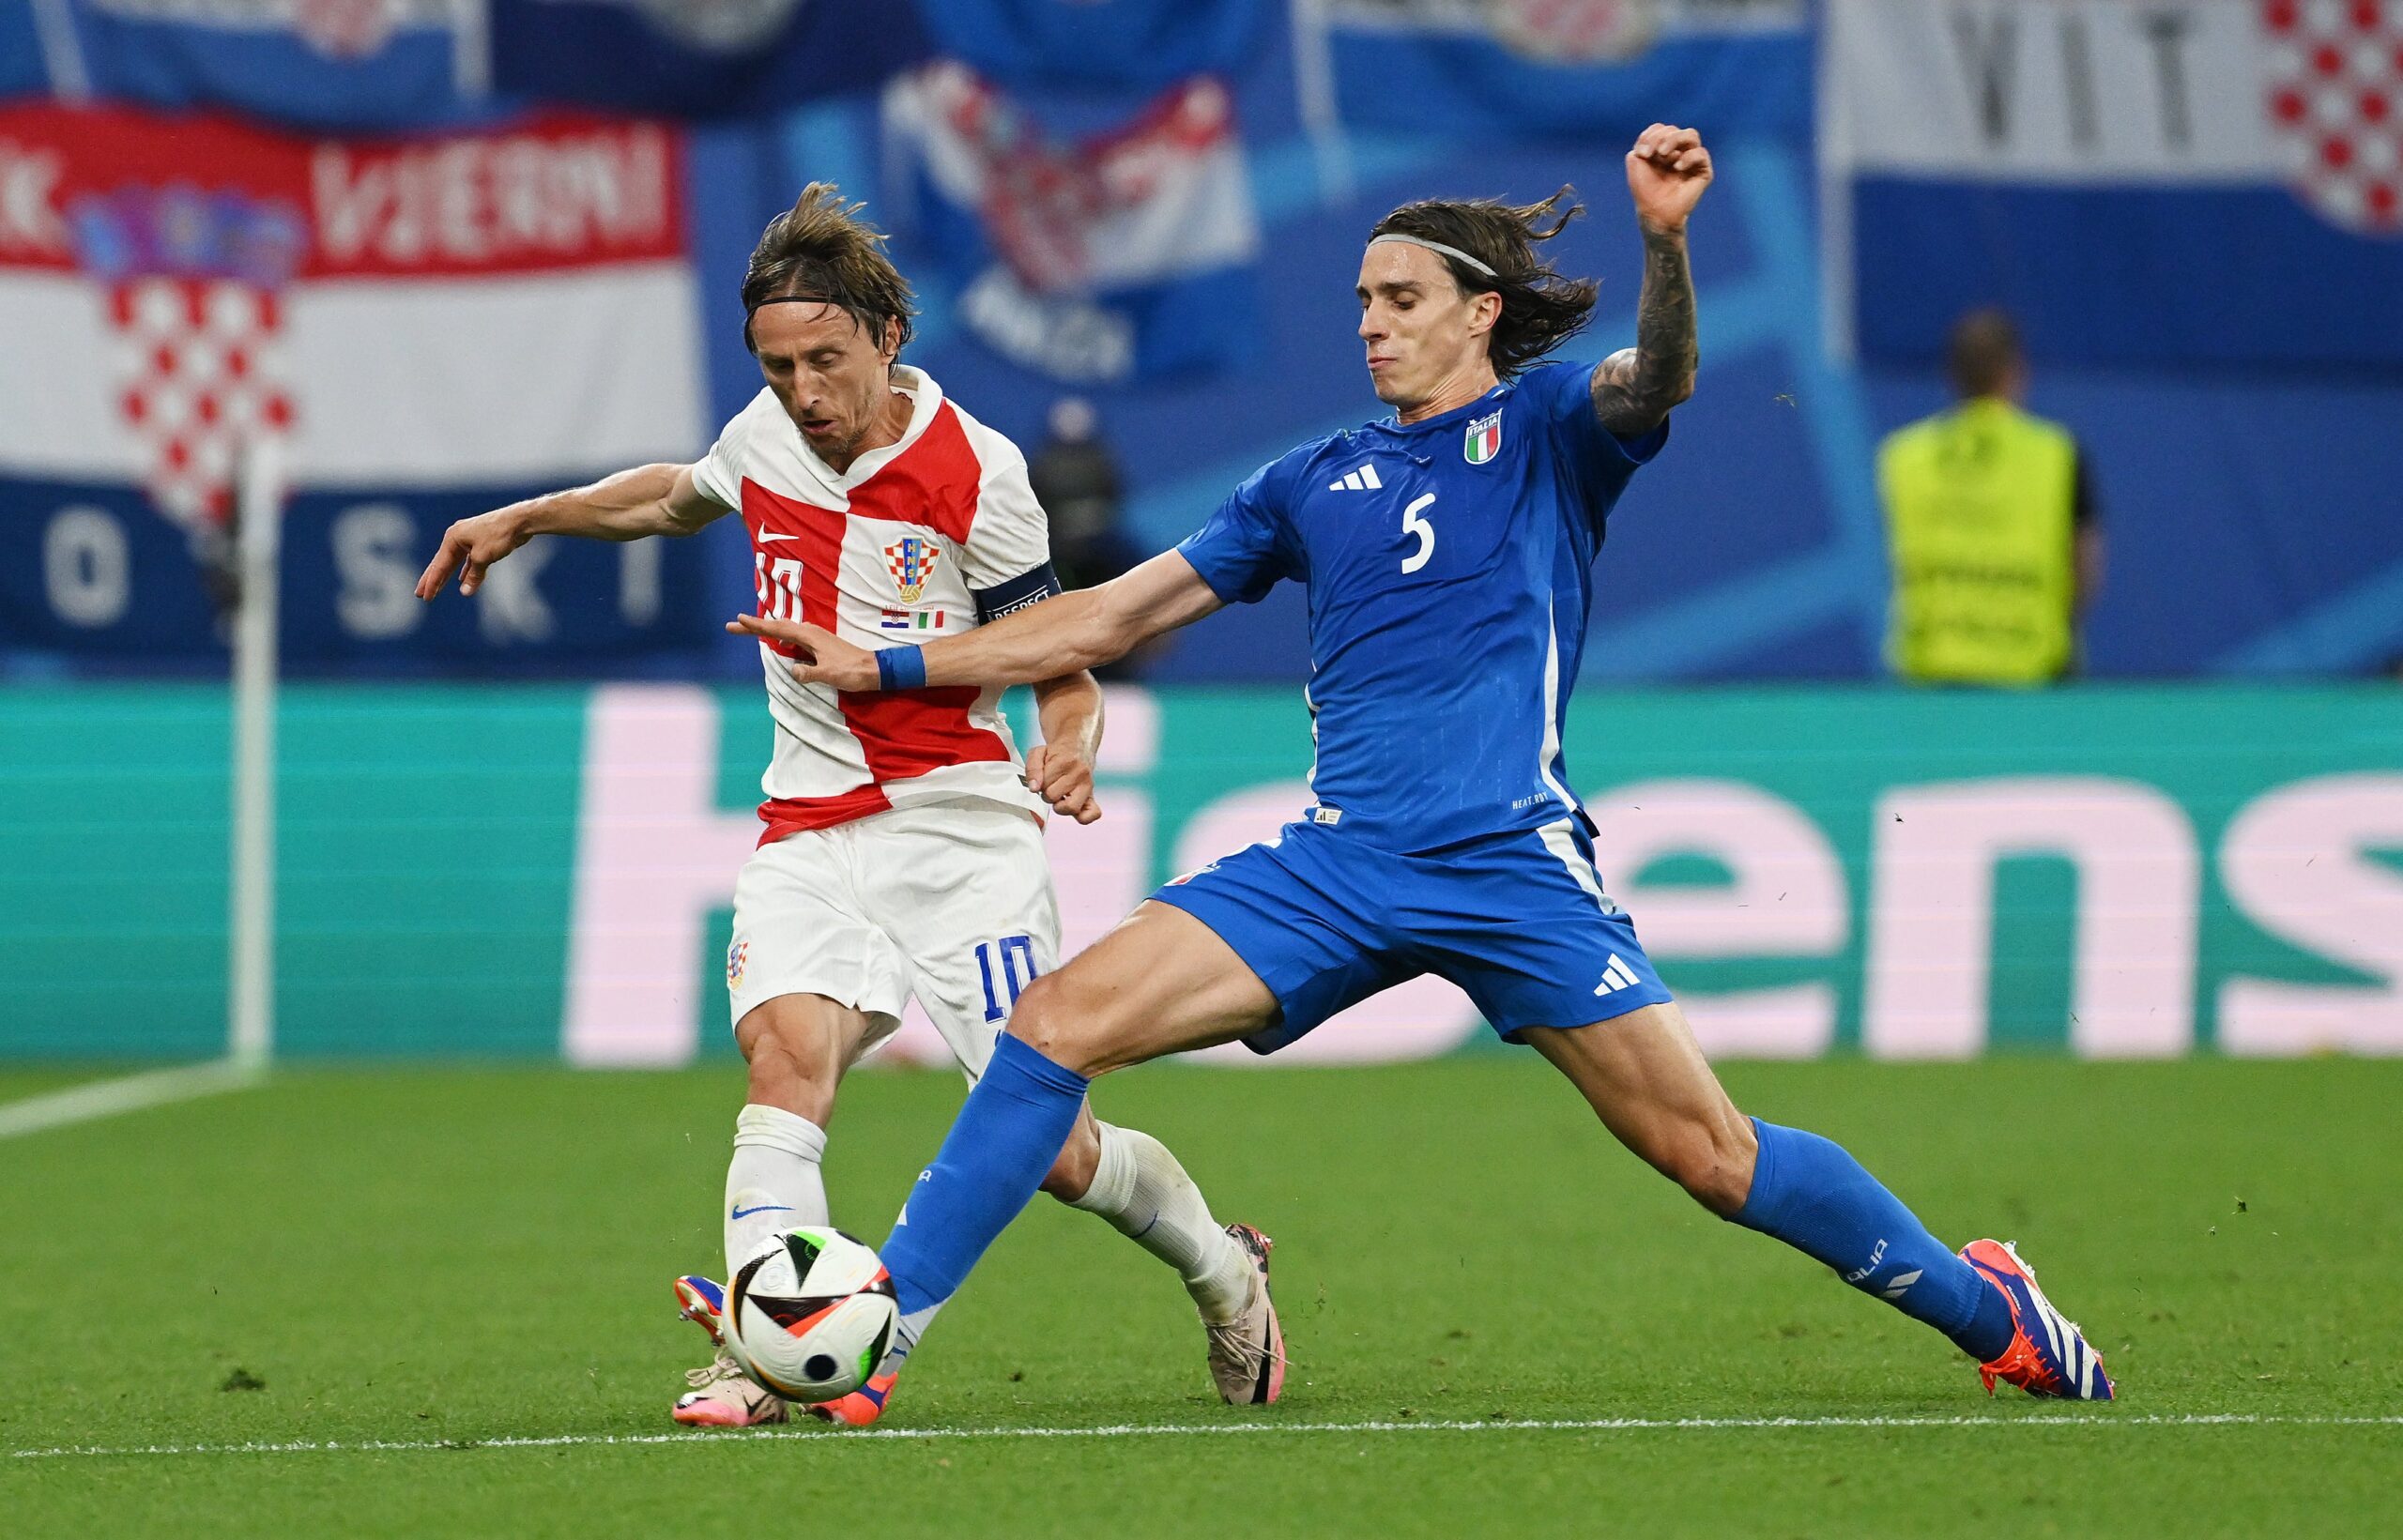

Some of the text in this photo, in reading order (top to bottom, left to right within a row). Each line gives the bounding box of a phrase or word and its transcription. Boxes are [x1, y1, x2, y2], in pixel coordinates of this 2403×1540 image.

[1469, 416, 1498, 437] ITALIA
[1401, 493, 1436, 574] 5
[1512, 791, 1549, 810] HEAT.RDY
[975, 936, 1037, 1024] 10
